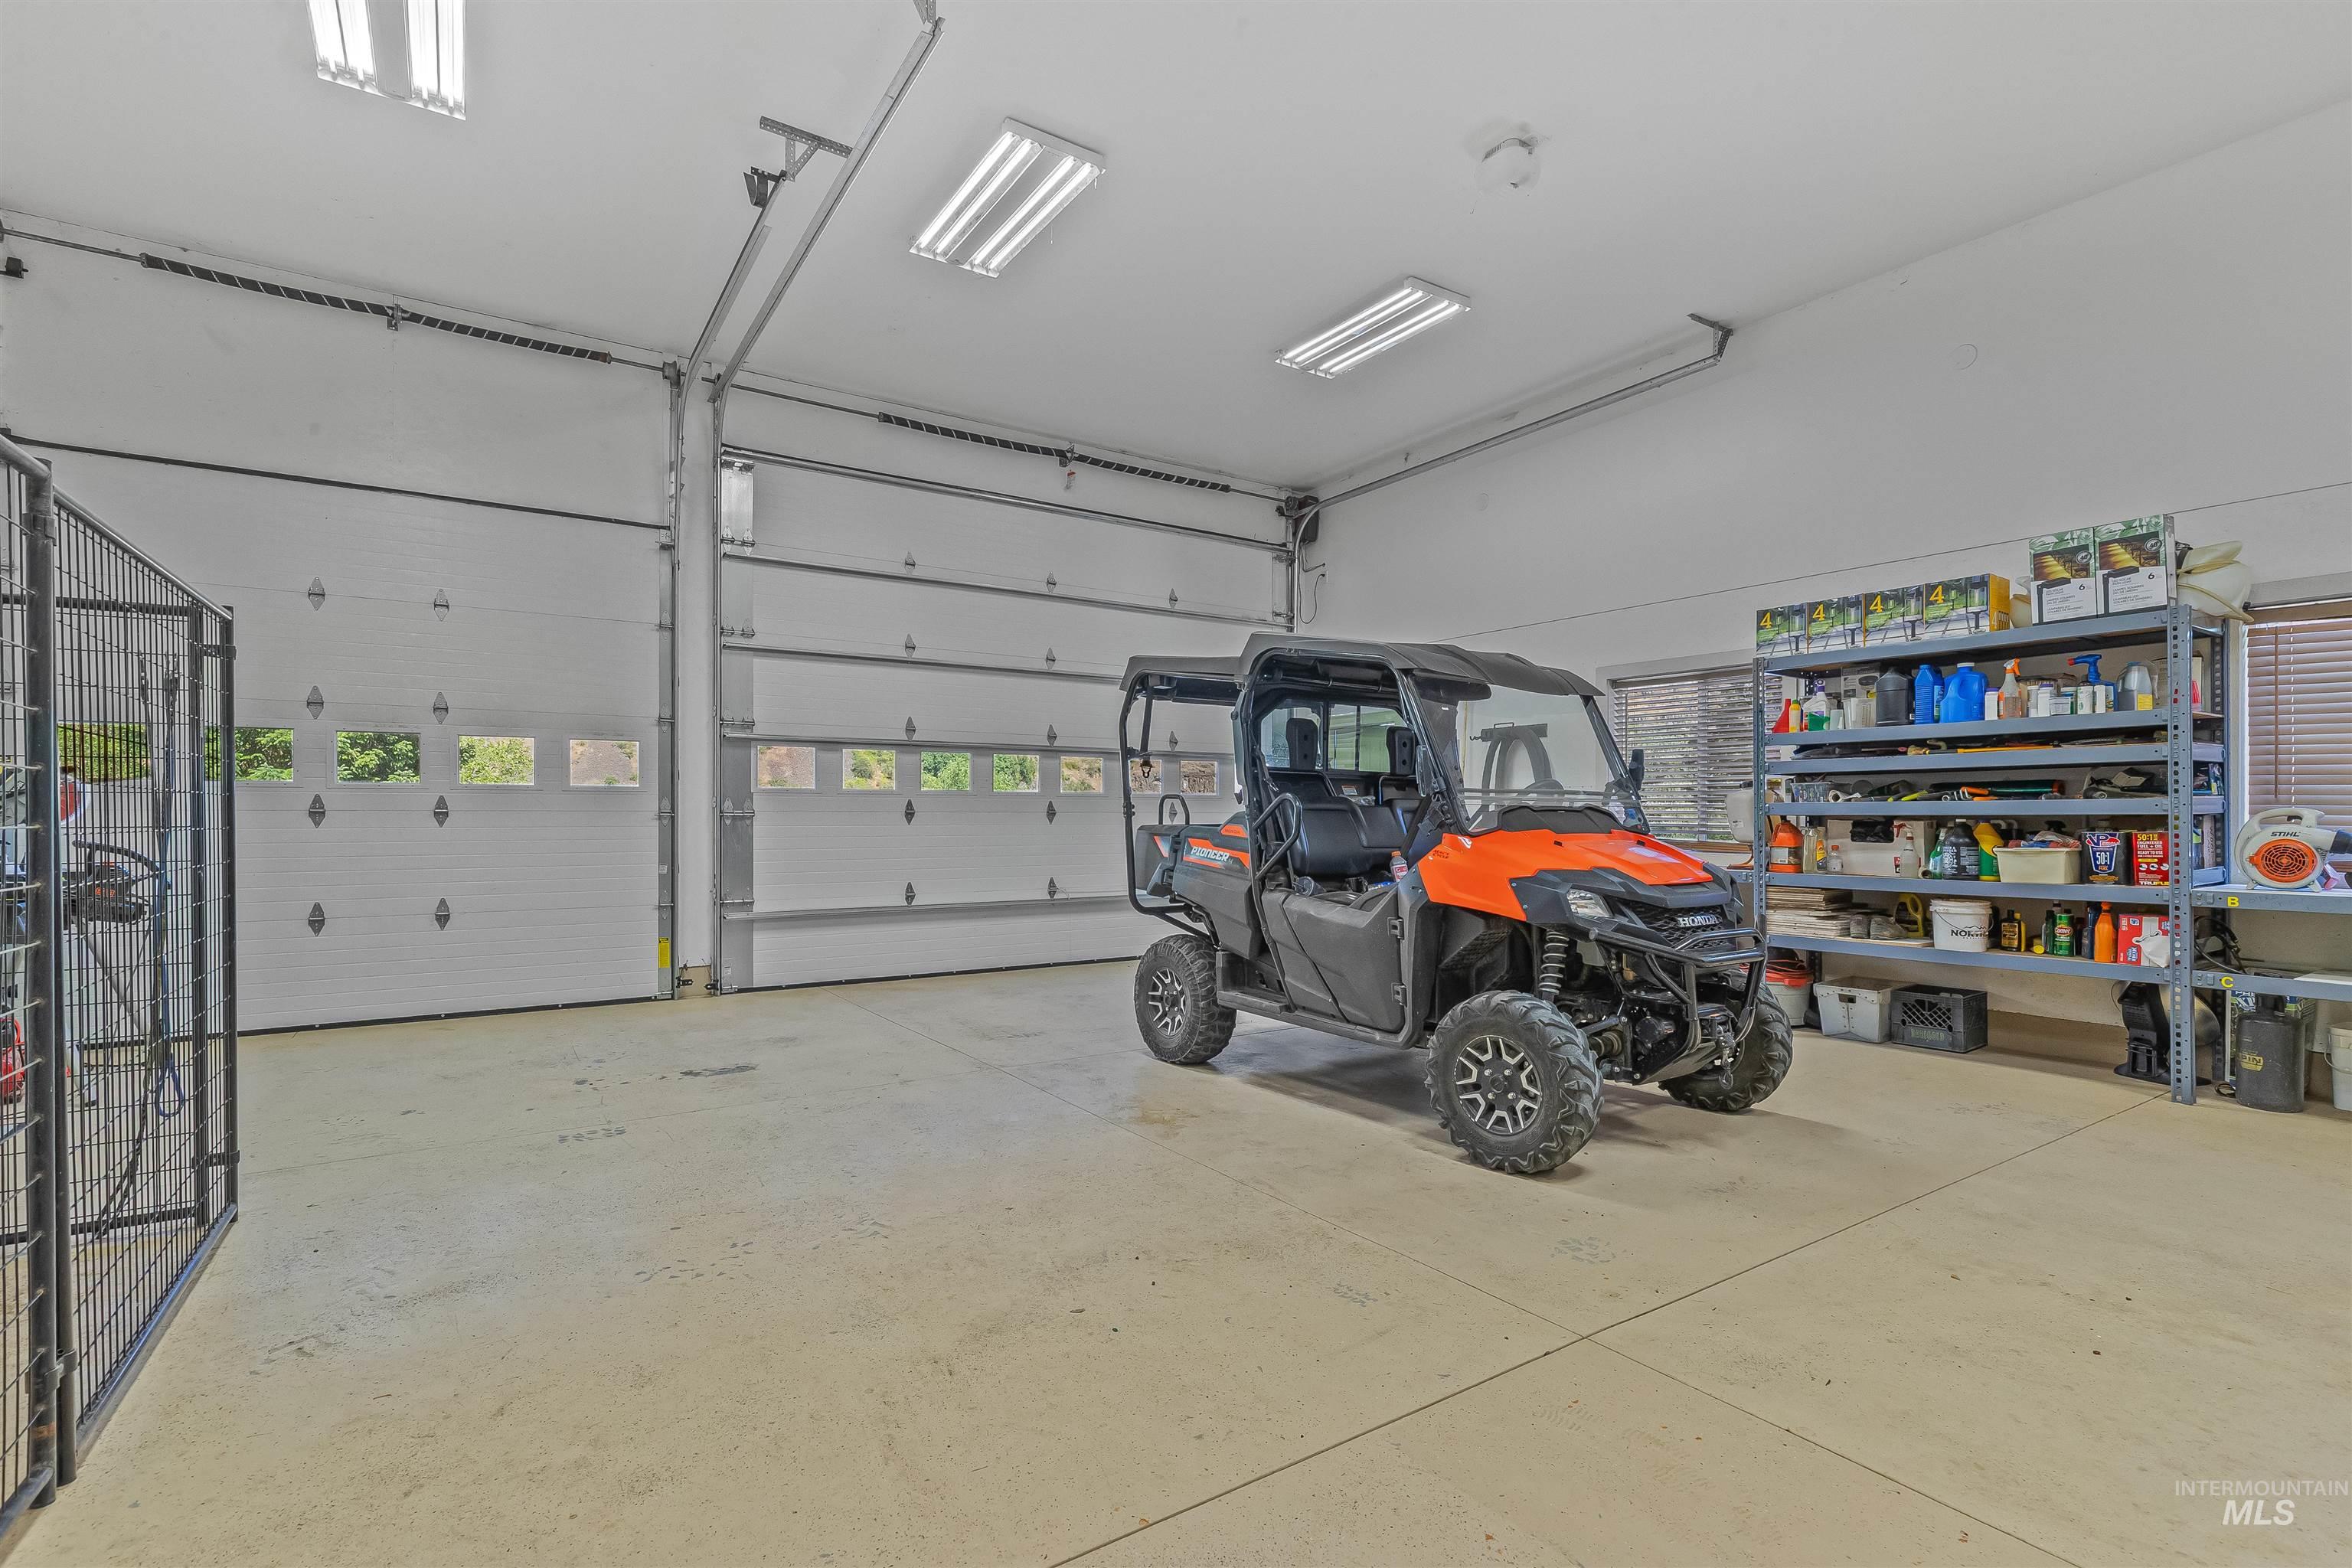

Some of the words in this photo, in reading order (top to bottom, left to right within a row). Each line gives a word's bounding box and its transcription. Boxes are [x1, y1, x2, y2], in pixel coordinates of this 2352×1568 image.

[1929, 585, 1944, 604] 4
[1869, 595, 1883, 613] 4
[1812, 603, 1826, 622] 4
[1760, 612, 1772, 629] 4
[1191, 847, 1230, 862] PIONEER
[2096, 852, 2110, 864] 50:1
[2227, 897, 2239, 907] B
[1678, 915, 1719, 928] HONDA
[2221, 976, 2234, 988] C
